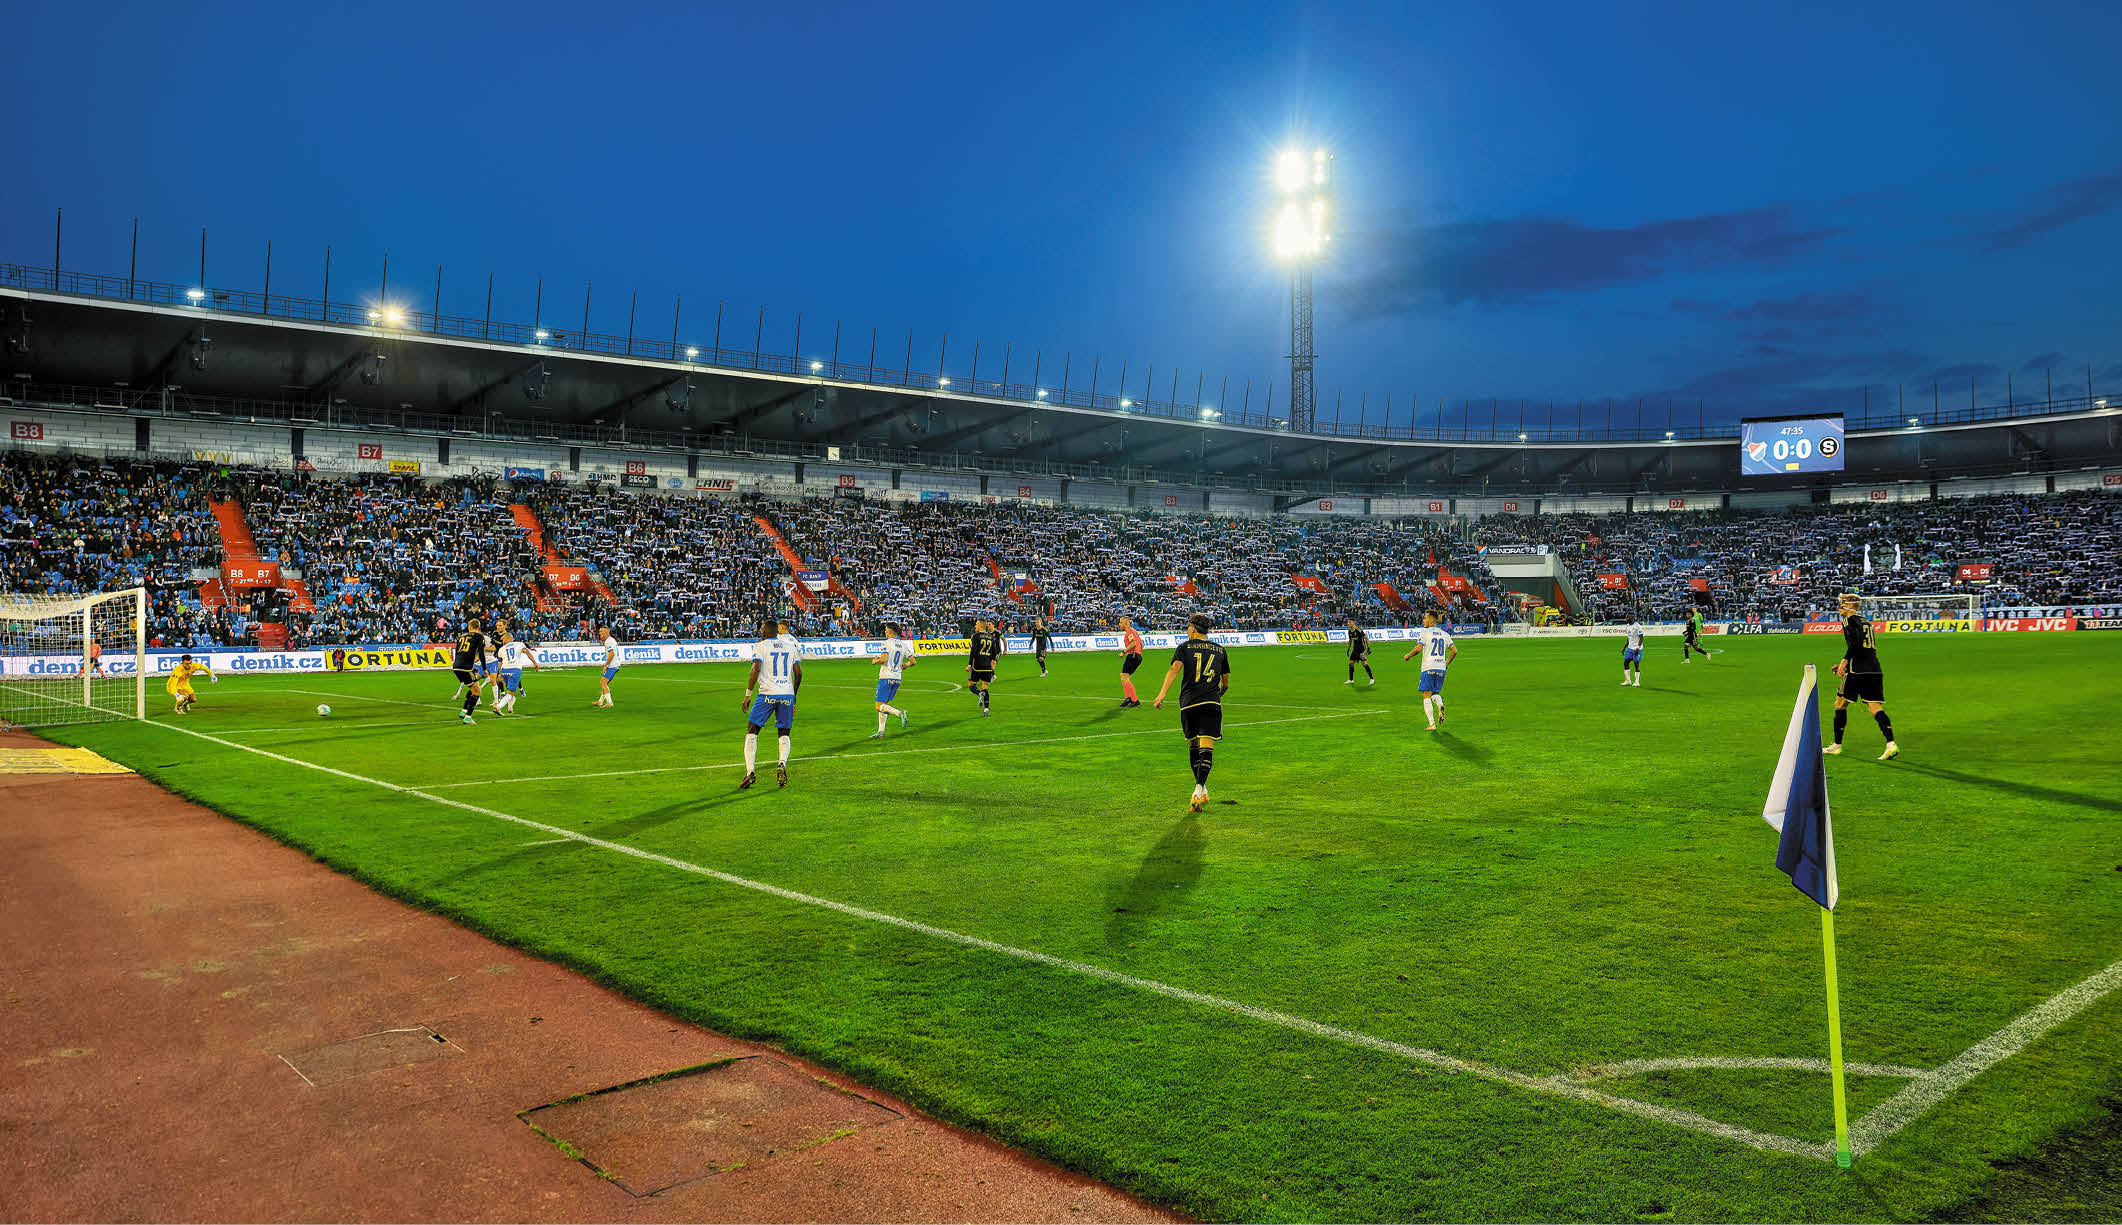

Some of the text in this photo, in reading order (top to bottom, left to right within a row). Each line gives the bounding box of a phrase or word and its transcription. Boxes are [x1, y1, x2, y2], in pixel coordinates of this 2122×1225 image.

[15, 424, 40, 438] B8
[1780, 426, 1804, 436] 47:35
[361, 446, 379, 457] B7
[1773, 438, 1812, 460] 0:0
[628, 463, 644, 473] B6
[1019, 487, 1030, 496] B4
[1872, 491, 1886, 499] D6
[1166, 496, 1176, 505] B3
[1320, 502, 1331, 510] B2
[1670, 499, 1682, 508] D7
[1430, 503, 1440, 511] B1
[1505, 503, 1516, 511] D8
[230, 569, 270, 578] B8 B7
[1744, 624, 1762, 634] LFA
[1889, 621, 1970, 632] FORTUNA
[1983, 620, 2019, 631] JVC
[2028, 619, 2067, 631] JVC
[1278, 631, 1325, 641] FORTUNA
[675, 646, 740, 659] deník.cz
[979, 639, 992, 656] 22
[347, 652, 447, 667] ORTUNA
[505, 647, 515, 661] 19
[626, 650, 660, 659] deník
[893, 650, 901, 669] 9
[231, 655, 323, 670] deník.cz
[770, 652, 789, 677] 11
[1193, 652, 1216, 683] 14
